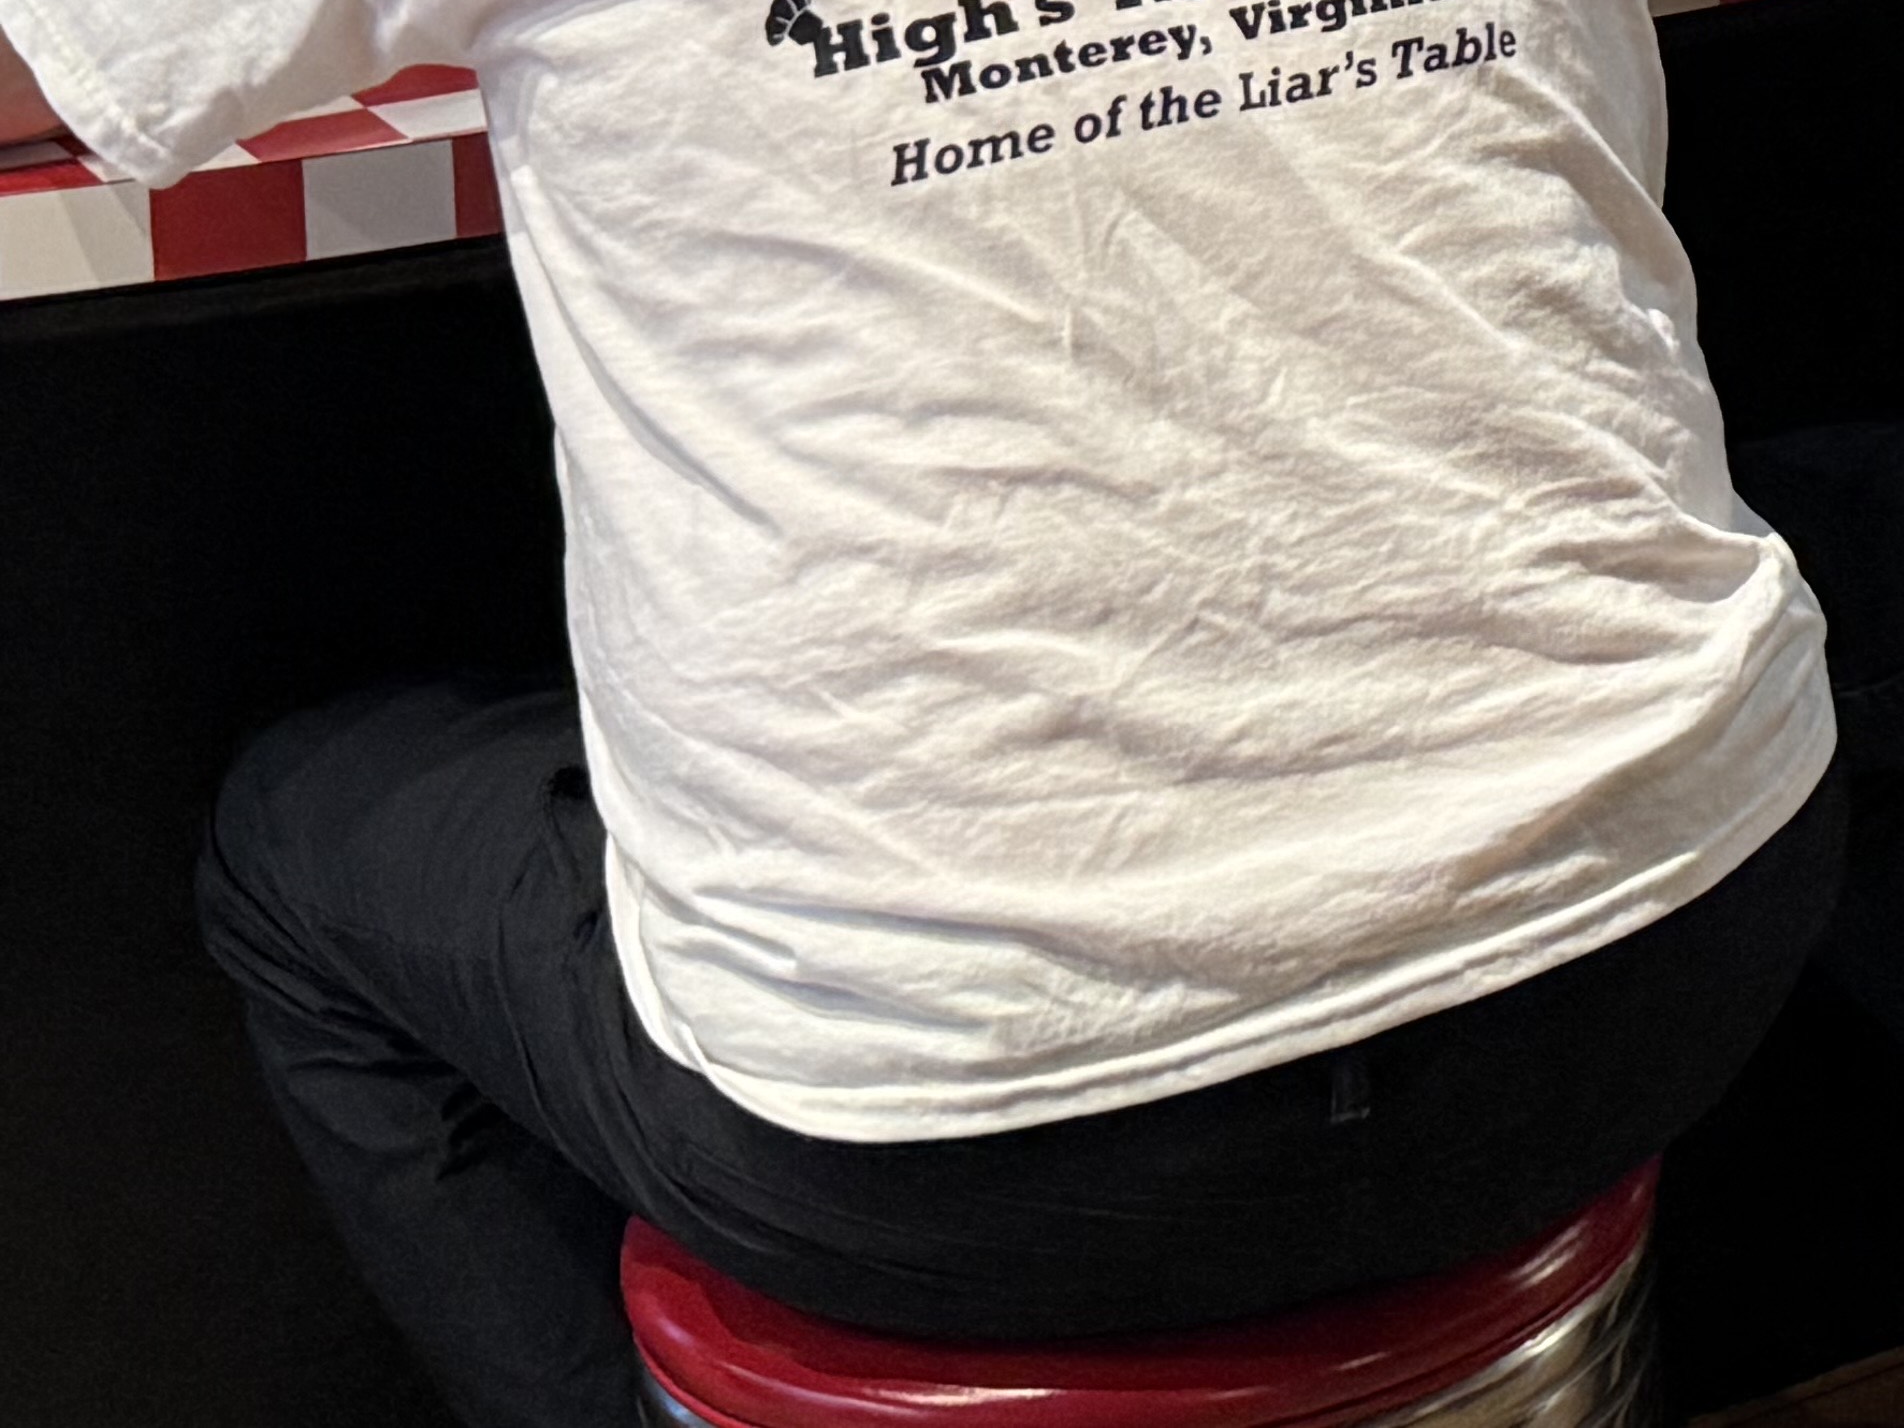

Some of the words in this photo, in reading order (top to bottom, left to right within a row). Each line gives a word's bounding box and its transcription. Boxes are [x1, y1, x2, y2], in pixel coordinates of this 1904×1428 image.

[889, 122, 1056, 186] Home
[1073, 94, 1125, 145] of
[1138, 82, 1223, 131] the
[1238, 49, 1378, 113] Liar's
[1390, 20, 1519, 80] Table
[919, 22, 1213, 106] Monterey,
